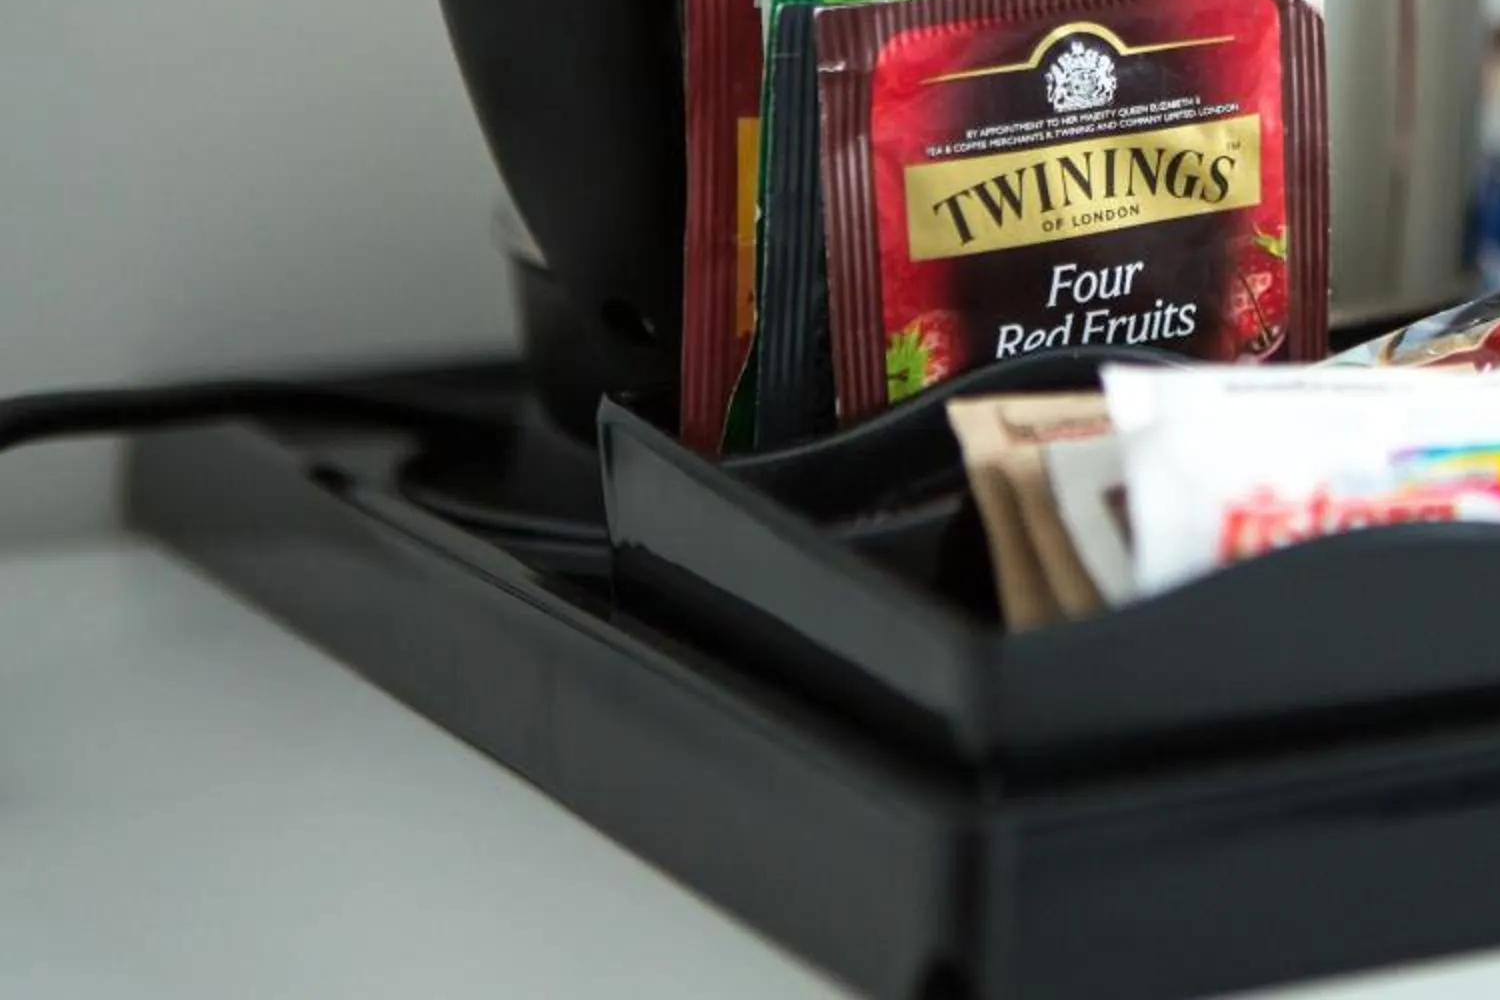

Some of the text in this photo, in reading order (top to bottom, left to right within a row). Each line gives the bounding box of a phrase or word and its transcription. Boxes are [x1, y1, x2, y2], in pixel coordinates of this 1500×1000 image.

[979, 122, 1044, 138] APPOINTMENT
[1046, 118, 1059, 129] TO
[989, 132, 1044, 149] MERCHANTS
[1119, 115, 1163, 129] COMPANY
[1197, 103, 1239, 117] LONDON
[932, 147, 1236, 247] TWININGS
[1042, 204, 1141, 234] OF LONDON
[1045, 259, 1145, 308] Four
[995, 298, 1198, 359] Red Fruits
